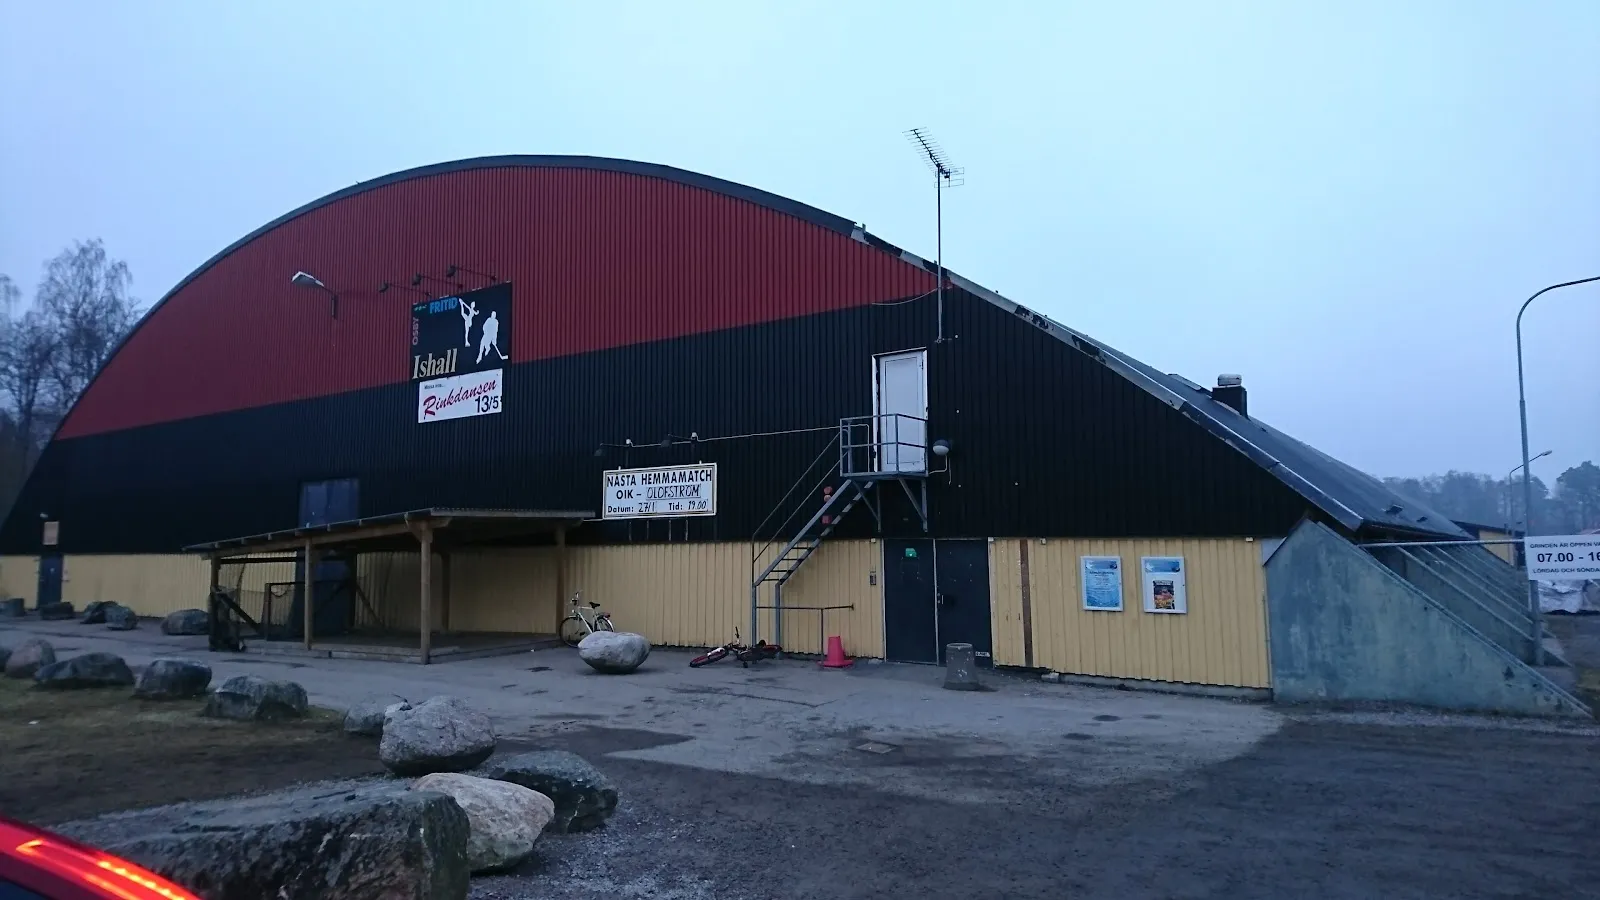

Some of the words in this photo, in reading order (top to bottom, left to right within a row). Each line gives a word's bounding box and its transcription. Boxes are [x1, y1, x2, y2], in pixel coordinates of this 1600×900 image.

[429, 297, 458, 314] FRITID
[412, 348, 458, 380] Ishall
[423, 380, 497, 420] Rinkdansen
[475, 395, 499, 413] 13/5
[607, 473, 636, 487] NÄSTA
[641, 469, 712, 485] HEMMAMATCH
[616, 489, 633, 499] OIK
[607, 505, 634, 513] Datum:
[638, 502, 655, 513] 27/1
[668, 502, 683, 511] Tid:
[688, 500, 707, 511] 19.00
[1537, 552, 1574, 563] 07.00
[1588, 551, 1600, 562] 16
